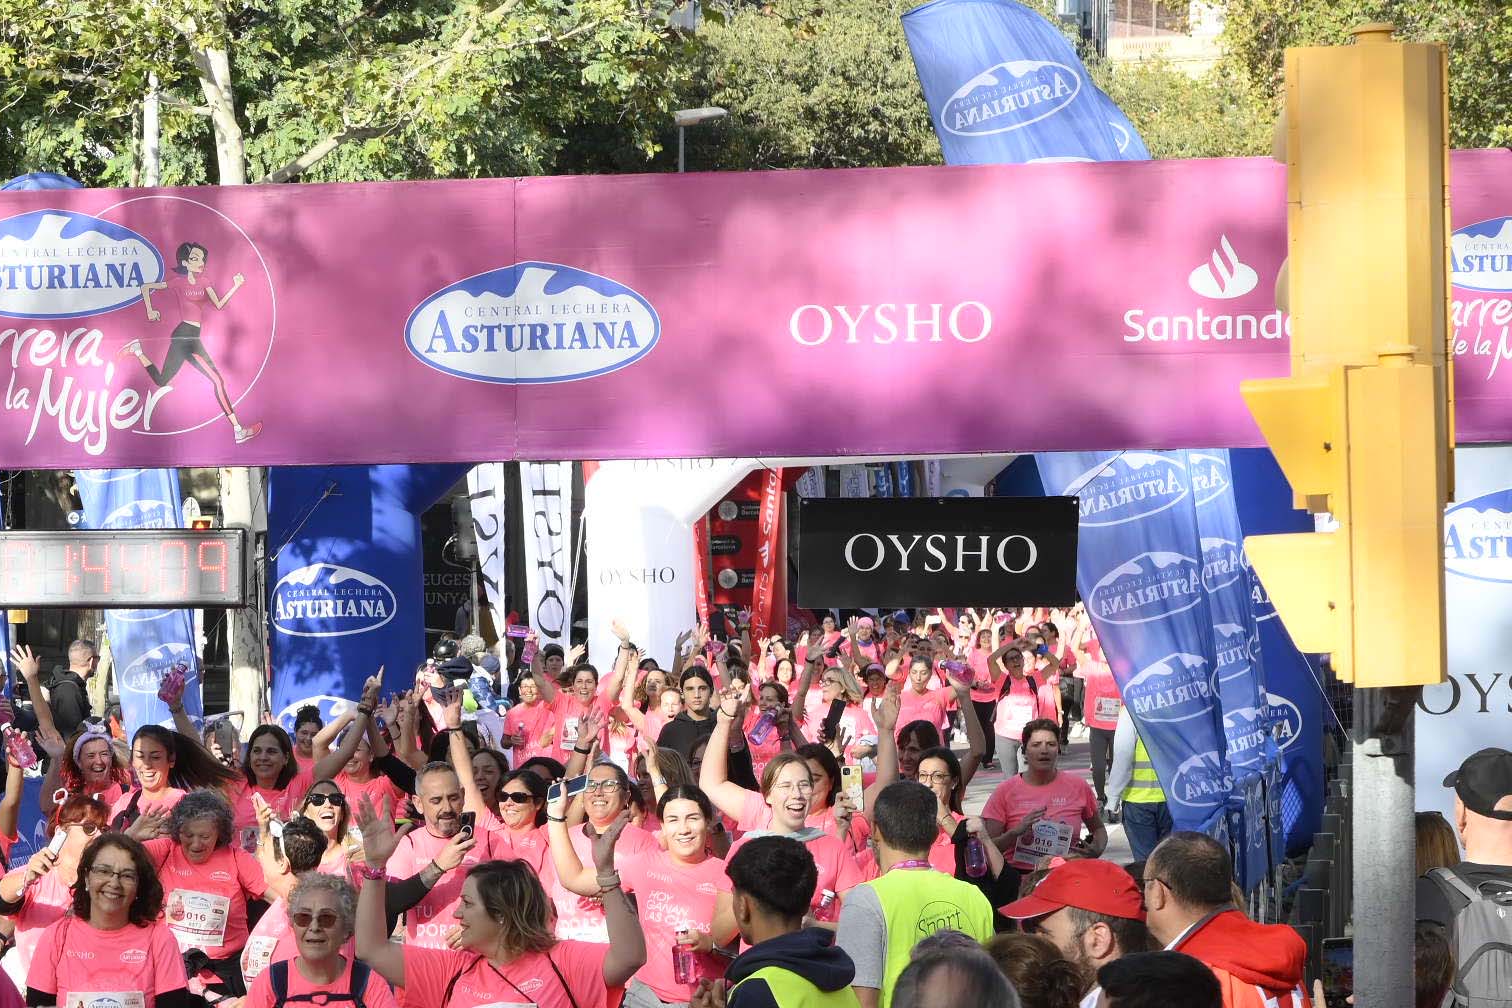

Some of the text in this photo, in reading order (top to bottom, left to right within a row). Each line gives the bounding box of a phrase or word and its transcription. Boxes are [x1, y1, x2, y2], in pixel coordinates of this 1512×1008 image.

[67, 245, 140, 257] LECHERA
[463, 301, 633, 319] CENTRAL LECHERA
[425, 309, 641, 354] ASTURIANA
[790, 300, 992, 345] OYSHO
[1474, 328, 1492, 356] la
[5, 368, 30, 410] la
[25, 361, 175, 456] Mujer
[844, 533, 1038, 574] OYSHO
[599, 566, 675, 585] OYSHO
[287, 588, 382, 598] CENTRAL LECHERA
[275, 593, 387, 620] ASTURIANA
[1417, 673, 1512, 716] OY
[1034, 837, 1053, 848] 016
[648, 891, 673, 902] HOY
[186, 911, 207, 922] 016
[415, 905, 433, 919] TU
[645, 911, 662, 922] LAS
[646, 899, 689, 918] GANAN
